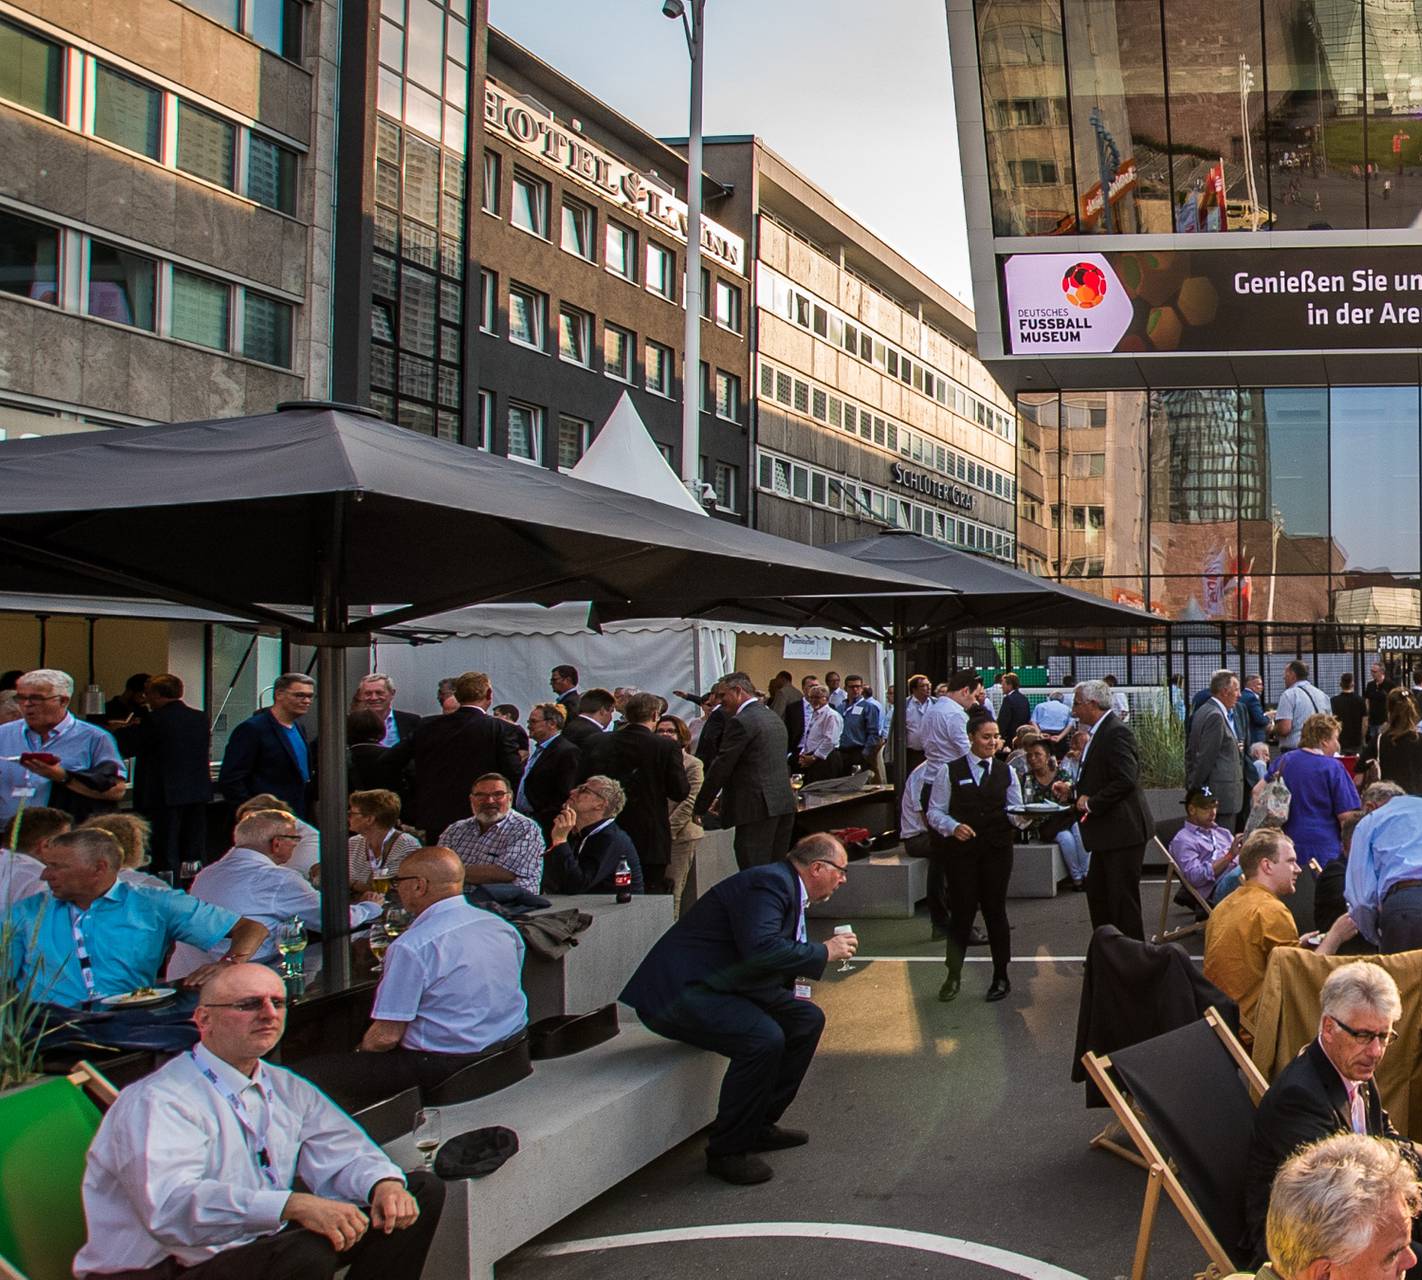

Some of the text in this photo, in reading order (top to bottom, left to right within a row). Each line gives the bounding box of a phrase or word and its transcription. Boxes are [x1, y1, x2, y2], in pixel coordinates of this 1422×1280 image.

[485, 88, 619, 195] HOTEL
[1234, 270, 1345, 294] Genießen
[1352, 269, 1388, 292] Sie
[1018, 308, 1069, 318] DEUTSCHES
[1307, 303, 1329, 325] in
[1336, 302, 1374, 325] der
[1019, 318, 1092, 330] FUSSBALL
[1020, 331, 1081, 343] MUSEUM
